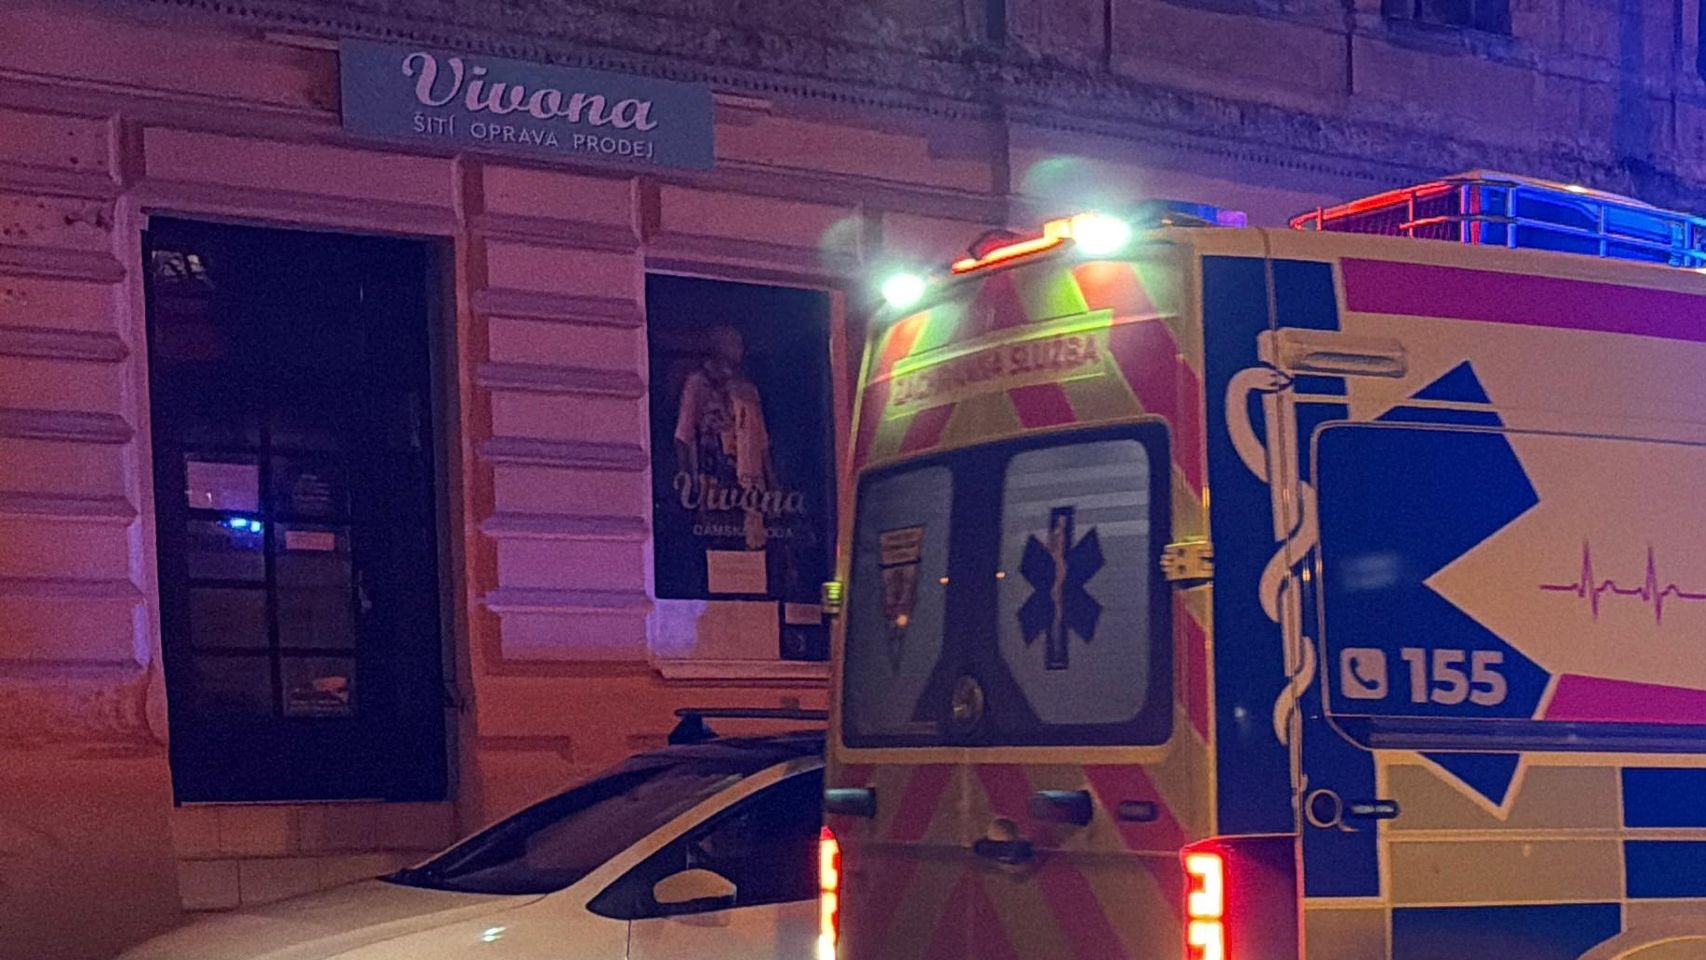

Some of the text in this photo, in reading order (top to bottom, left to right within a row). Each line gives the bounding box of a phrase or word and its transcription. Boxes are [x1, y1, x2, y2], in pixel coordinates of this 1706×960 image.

[402, 52, 658, 131] Vivona
[413, 111, 654, 159] ŠITÍ OPRAVA PRODEJ
[673, 471, 804, 517] Vivona
[1401, 647, 1508, 706] 155
